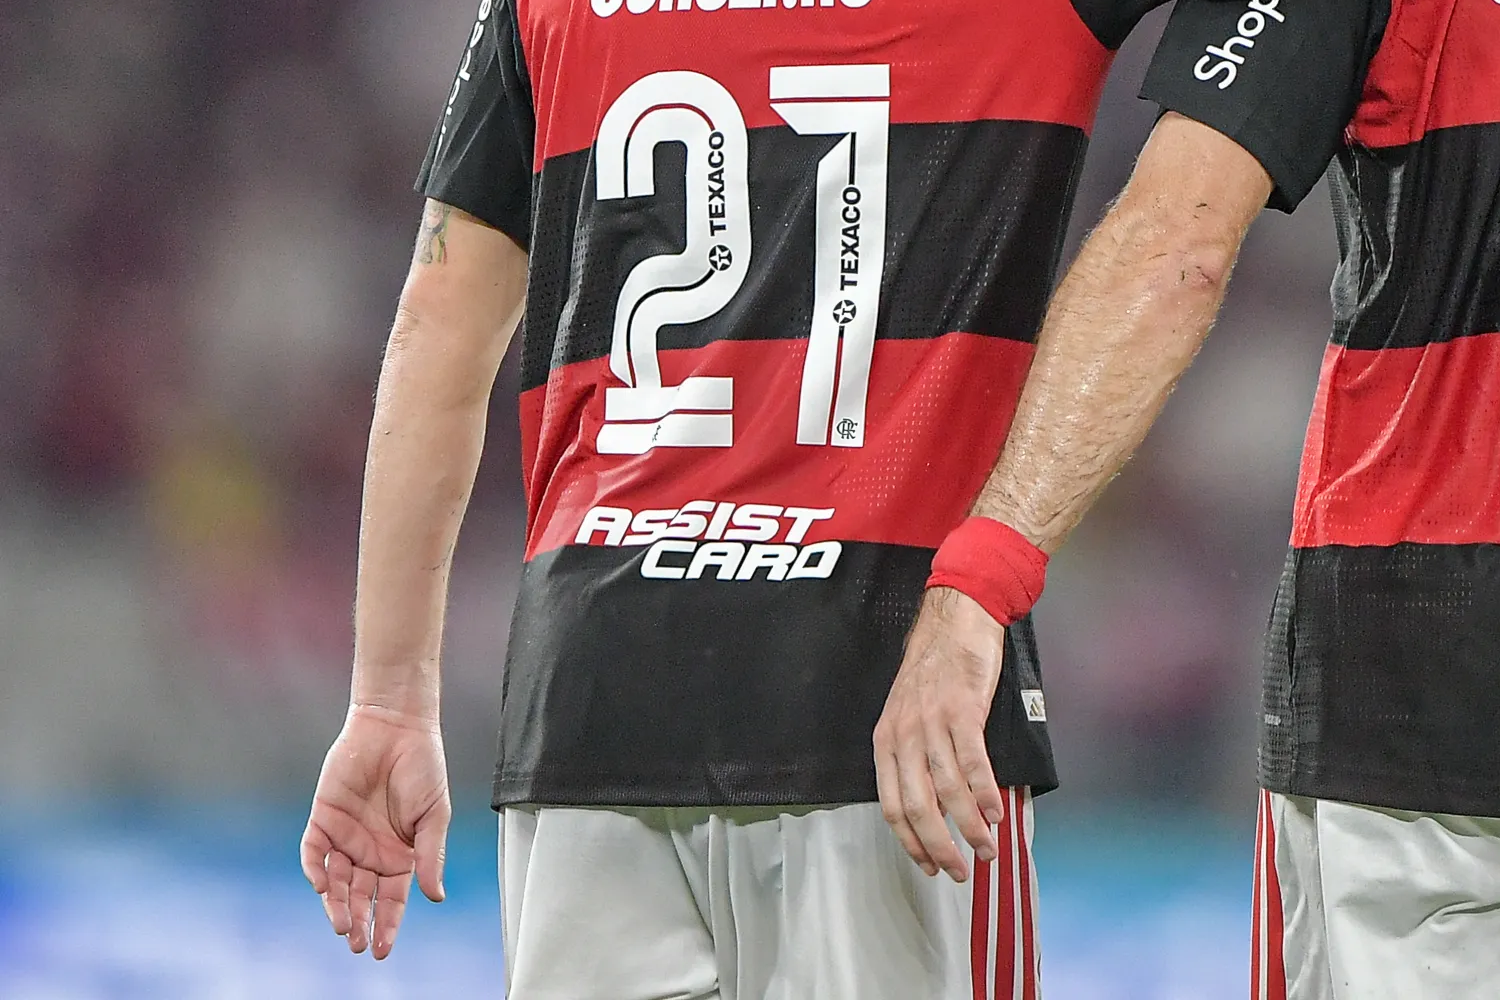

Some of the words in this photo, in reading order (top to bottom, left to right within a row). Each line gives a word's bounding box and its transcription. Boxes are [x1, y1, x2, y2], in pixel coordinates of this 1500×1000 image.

[707, 130, 727, 237] TEXACO
[595, 63, 891, 456] 21
[840, 185, 864, 291] TEXACO
[574, 499, 836, 547] ASSIST
[640, 539, 843, 582] CARD
